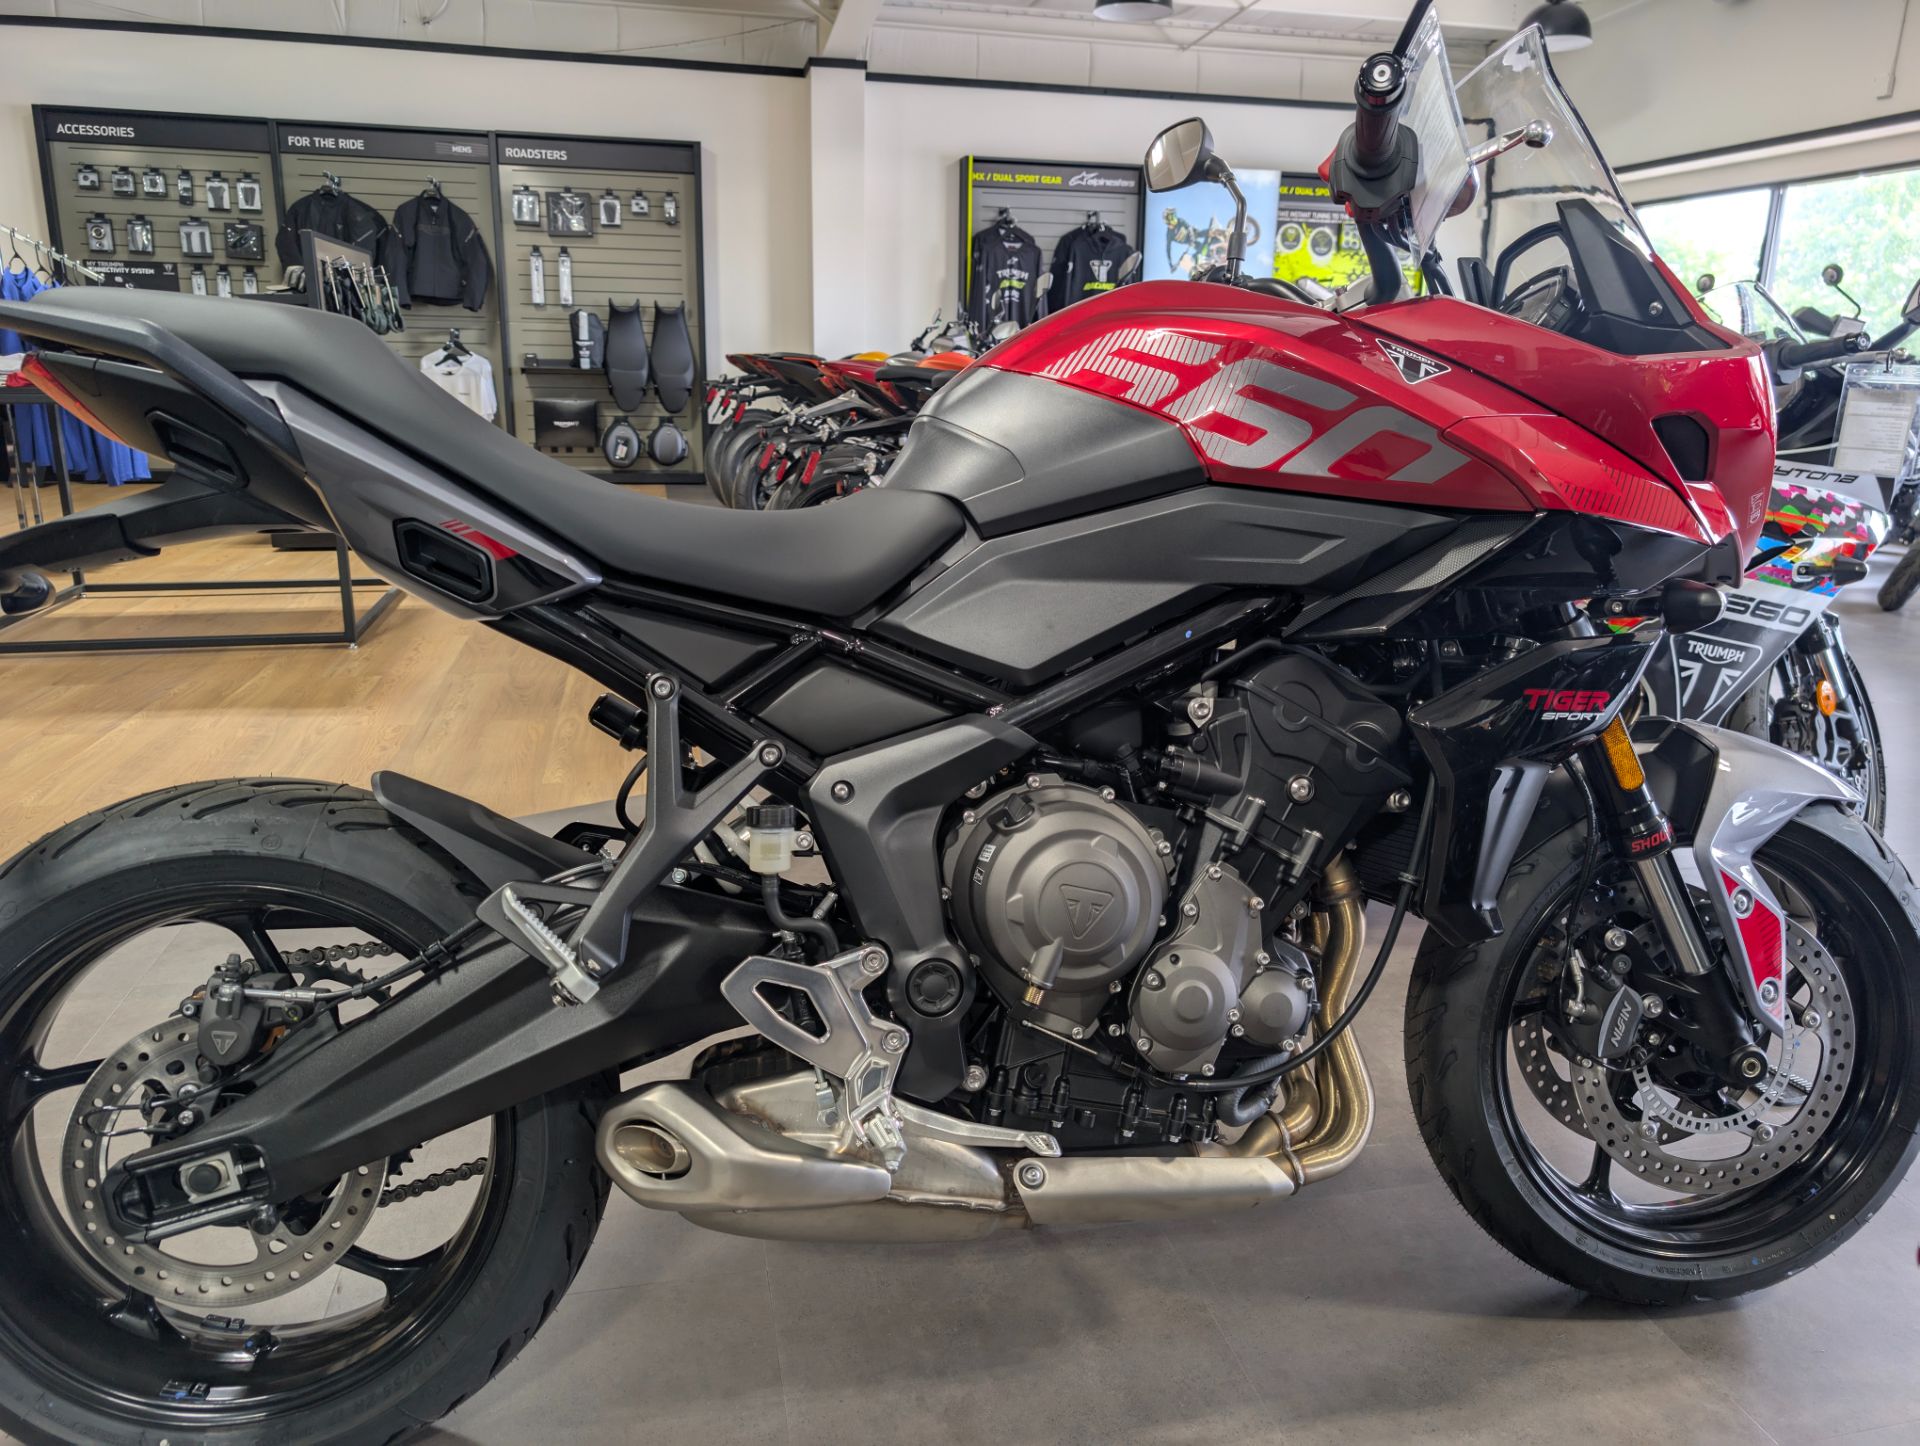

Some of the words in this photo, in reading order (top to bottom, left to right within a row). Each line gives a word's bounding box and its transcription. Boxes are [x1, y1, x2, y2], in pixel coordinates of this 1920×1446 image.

[56, 123, 135, 138] ACCESSORIES
[287, 136, 310, 147] FOR
[313, 137, 336, 148] THE
[338, 138, 365, 150] RIDE
[505, 147, 568, 161] ROADSTERS
[992, 173, 1014, 182] DUAL
[1015, 174, 1040, 184] SPORT
[1041, 175, 1063, 185] GEAR
[131, 267, 156, 275] SYSTEM
[1390, 344, 1436, 366] TRIUMPH
[1041, 327, 1472, 484] 660
[1687, 640, 1746, 664] TRIUMPH
[1523, 688, 1611, 712] TIGER
[1541, 712, 1606, 722] SPORT
